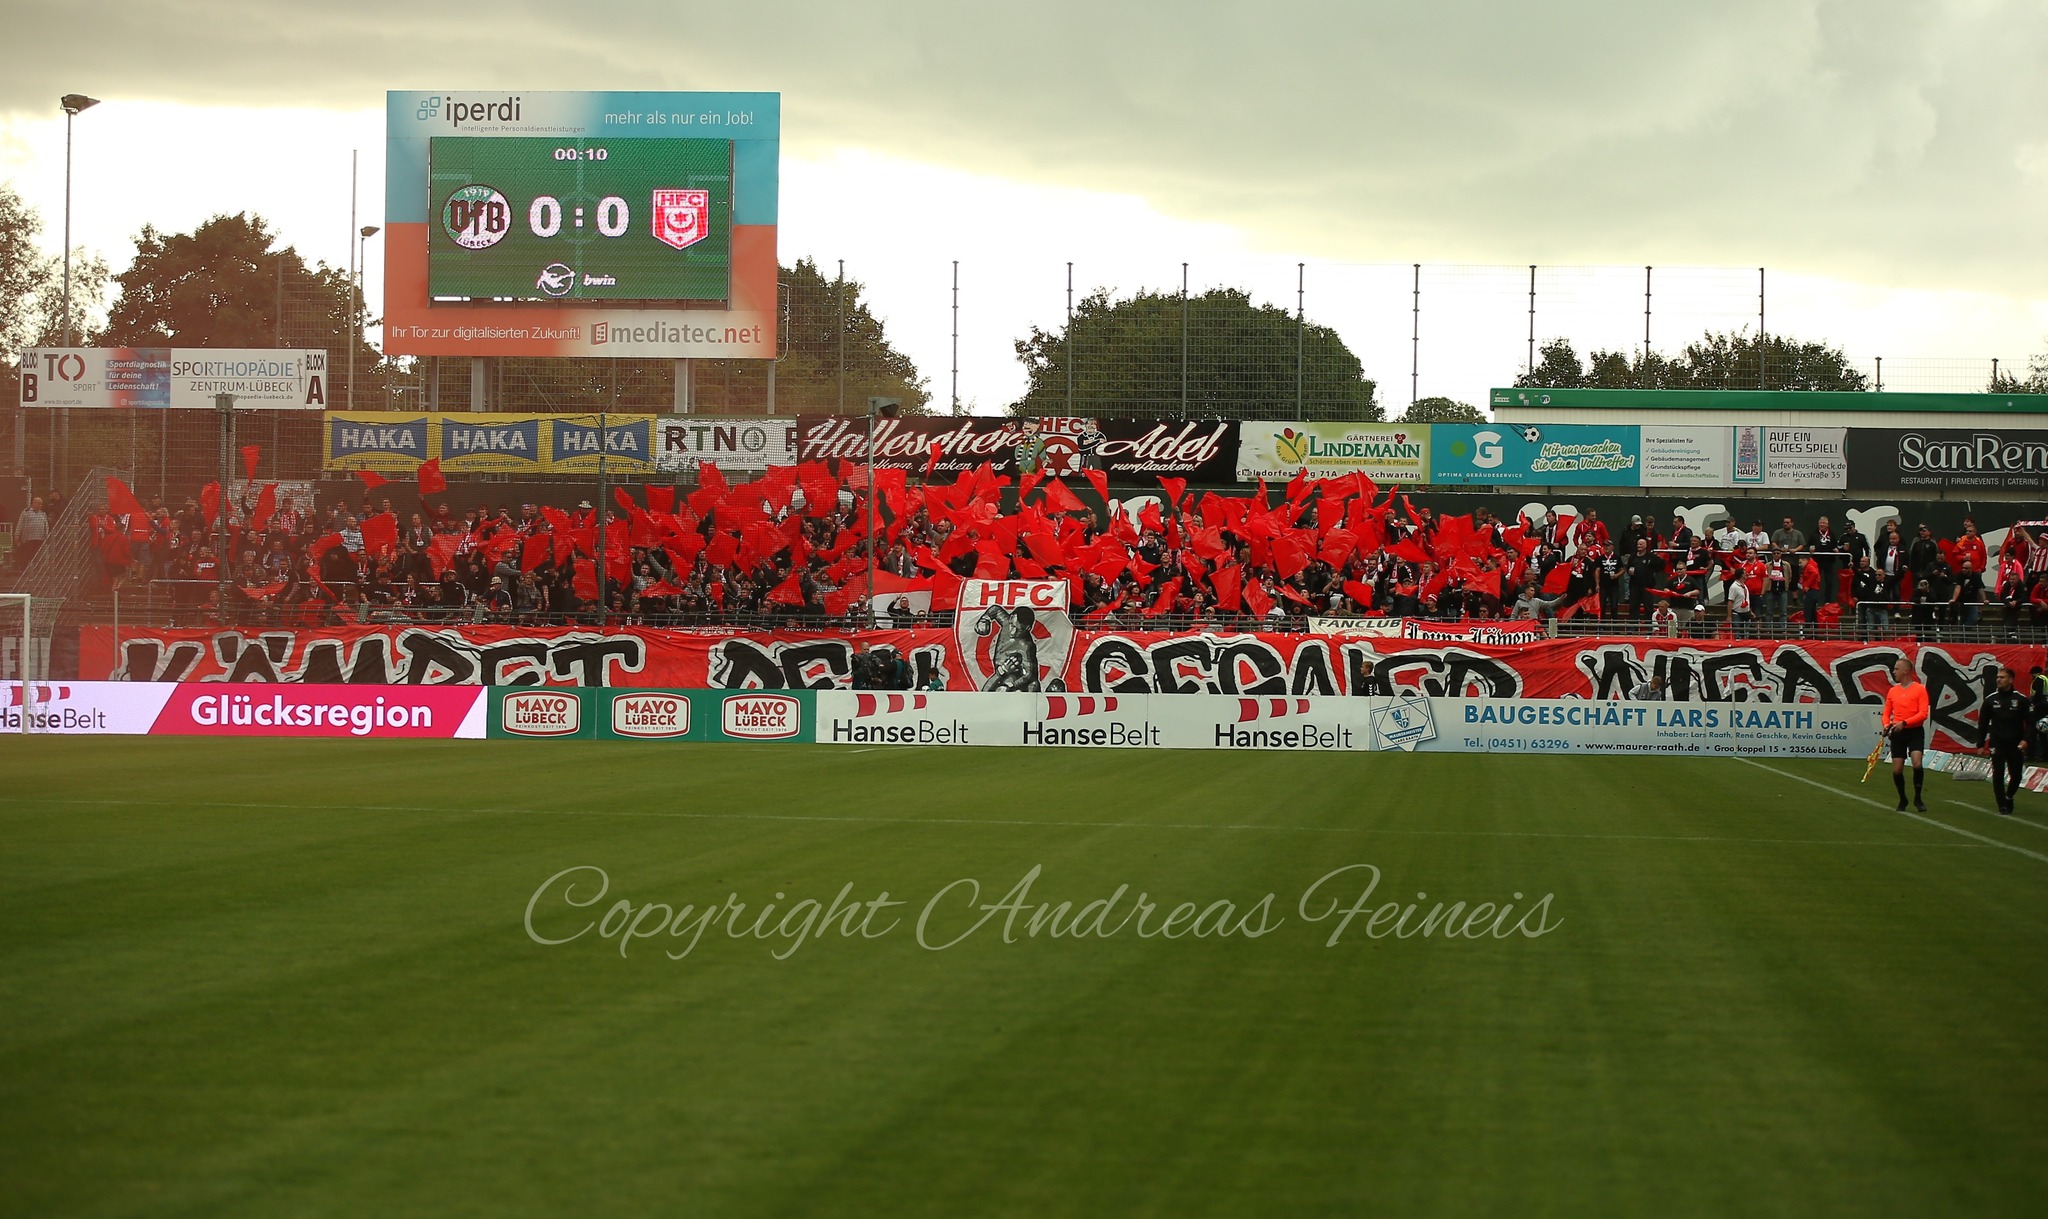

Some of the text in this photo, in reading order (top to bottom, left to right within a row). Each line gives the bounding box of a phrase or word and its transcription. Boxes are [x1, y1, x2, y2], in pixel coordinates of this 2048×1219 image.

[445, 97, 521, 127] iperdi
[605, 110, 754, 126] mehr als nur ein Job!
[461, 125, 499, 133] intelligente
[554, 148, 608, 161] 00:10
[660, 194, 702, 206] HFC
[529, 196, 562, 237] 0
[596, 196, 630, 237] 0
[583, 274, 617, 286] bwin
[392, 326, 580, 341] Ihr Tor zur digitalisierten Zukunft!
[611, 321, 762, 344] mediatec.net
[109, 360, 167, 370] Sportdiagnostik
[172, 359, 294, 377] SPORTHOPÄDIE
[306, 354, 325, 371] BLOCK
[109, 371, 142, 380] für deine
[22, 373, 38, 402] B
[73, 383, 97, 392] SPORT
[108, 382, 159, 391] Leidenschaft!
[305, 375, 325, 405] A
[1040, 416, 1085, 434] HFC
[341, 428, 416, 449] HAKA
[452, 430, 527, 451] HAKA
[563, 431, 638, 451] HAKA
[1096, 421, 1228, 461] Adel
[1346, 434, 1393, 442] GÄRTNEREI
[1769, 432, 1811, 442] AUF EIN
[1309, 435, 1421, 458] LINDEMANN
[1542, 440, 1621, 457] Mit uns machen
[1769, 443, 1838, 454] GUTES SPIEL!
[1309, 458, 1333, 466] Schöner
[1334, 458, 1349, 466] leben
[1350, 458, 1361, 466] mit
[1393, 459, 1419, 467] Pflanzen
[1531, 455, 1635, 472] Sie einen Volltreffer!
[1769, 461, 1847, 471] kaffeehaus-lübeck.de
[1792, 470, 1829, 479] Hüxstraße
[1831, 471, 1841, 479] 35
[1901, 477, 2039, 486] RESTAURANT FIRMENEVENTS CATERING
[980, 582, 1054, 606] HFC
[1317, 619, 1402, 628] FANCLUB
[516, 698, 568, 712] MAYO
[625, 700, 677, 714] MAYO
[735, 701, 787, 715] MAYO
[191, 695, 432, 736] Glücksregion
[1464, 702, 1848, 730] BAUGESCHÄFT LARS RAATH OHG
[833, 719, 969, 744] HanseBelt
[1023, 721, 1160, 746] HanseBelt
[1215, 723, 1353, 749] HanseBelt
[1709, 731, 1733, 739] Raath,
[1756, 732, 1790, 740] Geschke,
[1815, 733, 1847, 741] Geschke
[1464, 738, 1847, 754] Tel. (0451) 63296 www.maurer-raath.de Grookoppel 15 23566 Lübeck
